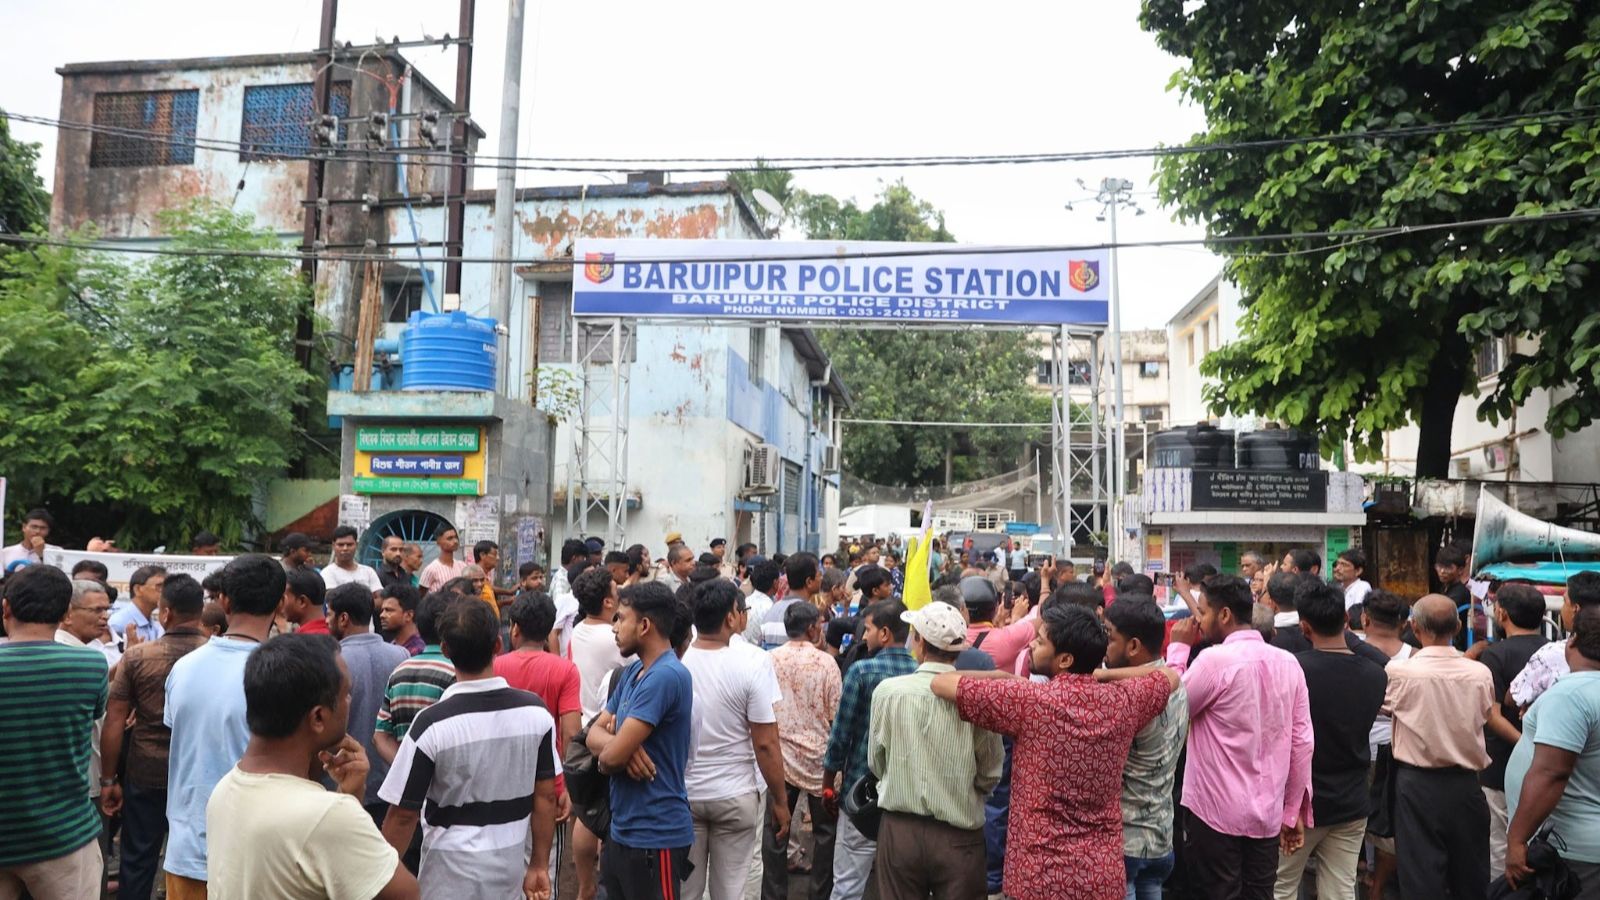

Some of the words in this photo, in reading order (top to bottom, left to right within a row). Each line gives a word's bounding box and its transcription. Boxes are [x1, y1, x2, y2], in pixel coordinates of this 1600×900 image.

[623, 262, 786, 292] BARUIPUR
[798, 265, 913, 294] POLICE
[924, 267, 1061, 297] STATION
[672, 293, 796, 306] BARUIPUR
[803, 295, 891, 308] POLICE
[898, 297, 1010, 310] DISTRICT
[723, 304, 772, 314] PHONE
[776, 306, 836, 315] NUMBER
[848, 307, 874, 316] 033
[166, 561, 206, 572] সরকারের
